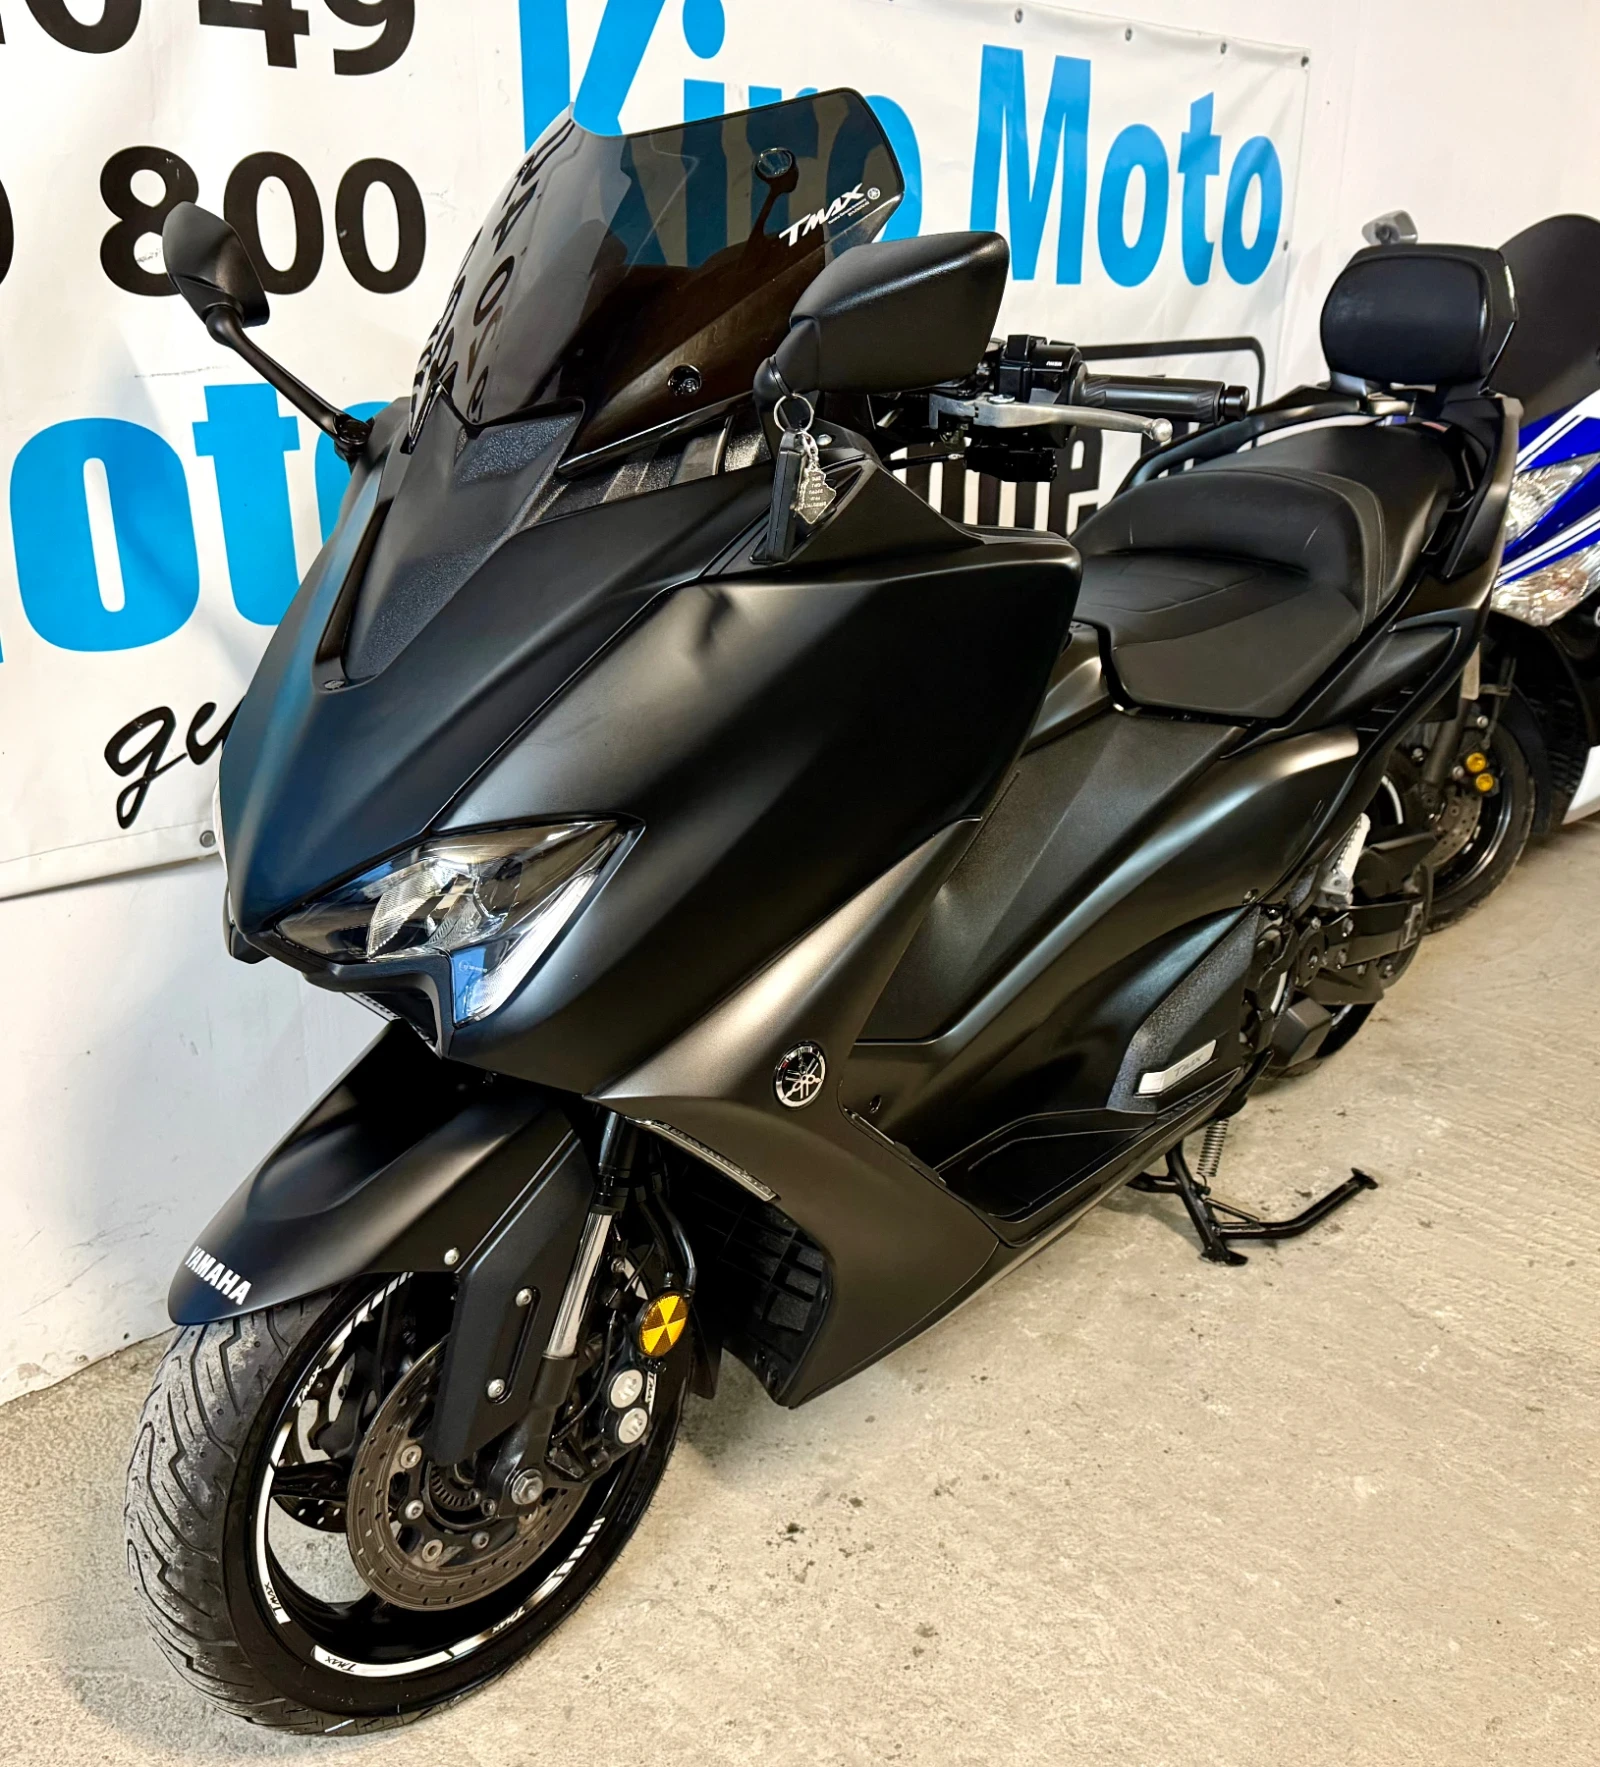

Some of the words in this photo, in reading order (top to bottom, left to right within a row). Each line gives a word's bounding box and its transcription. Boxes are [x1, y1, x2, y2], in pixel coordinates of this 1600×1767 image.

[969, 44, 1282, 287] Moto
[100, 146, 426, 297] 800
[779, 183, 864, 247] TMAX
[185, 1246, 252, 1305] YAMAHA
[325, 1656, 356, 1672] TMAX
